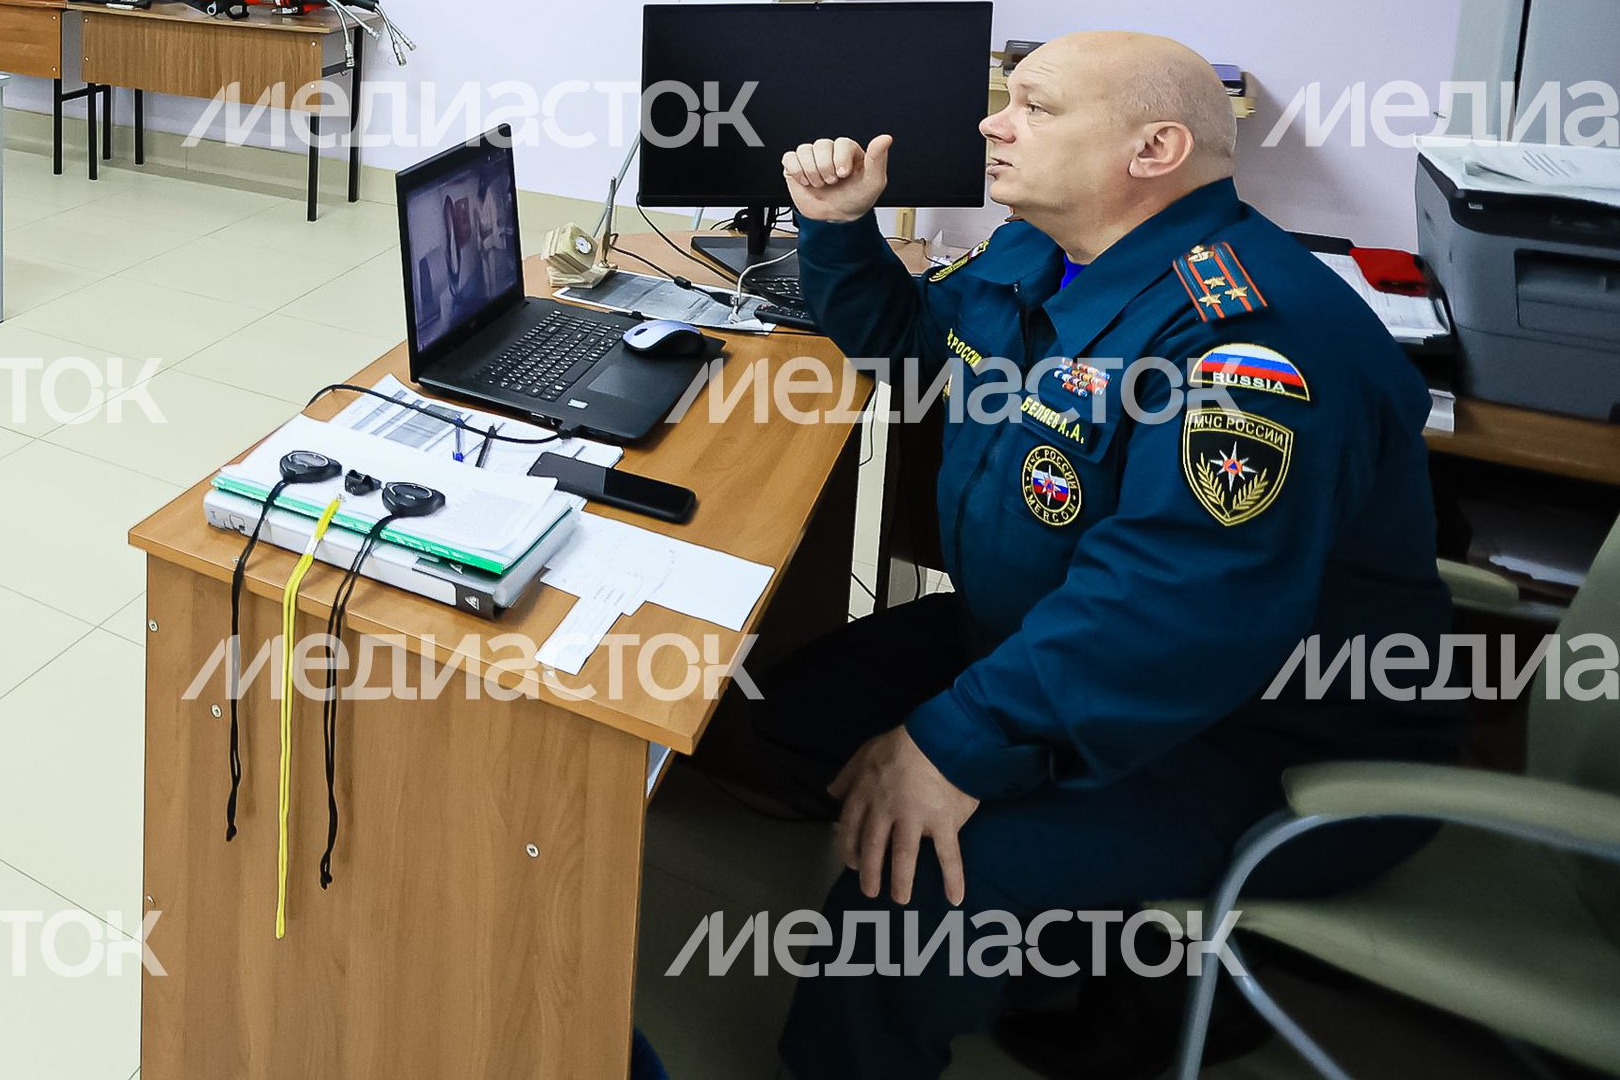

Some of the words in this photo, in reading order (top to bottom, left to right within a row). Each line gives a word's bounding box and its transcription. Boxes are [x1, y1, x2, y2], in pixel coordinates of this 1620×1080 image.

[1212, 371, 1286, 393] RUSSIA
[1019, 396, 1061, 429] БЕЛЯЕВ
[1193, 415, 1222, 429] МЧС
[1226, 417, 1284, 447] РОССИИ
[1044, 449, 1078, 489] РОССИИ
